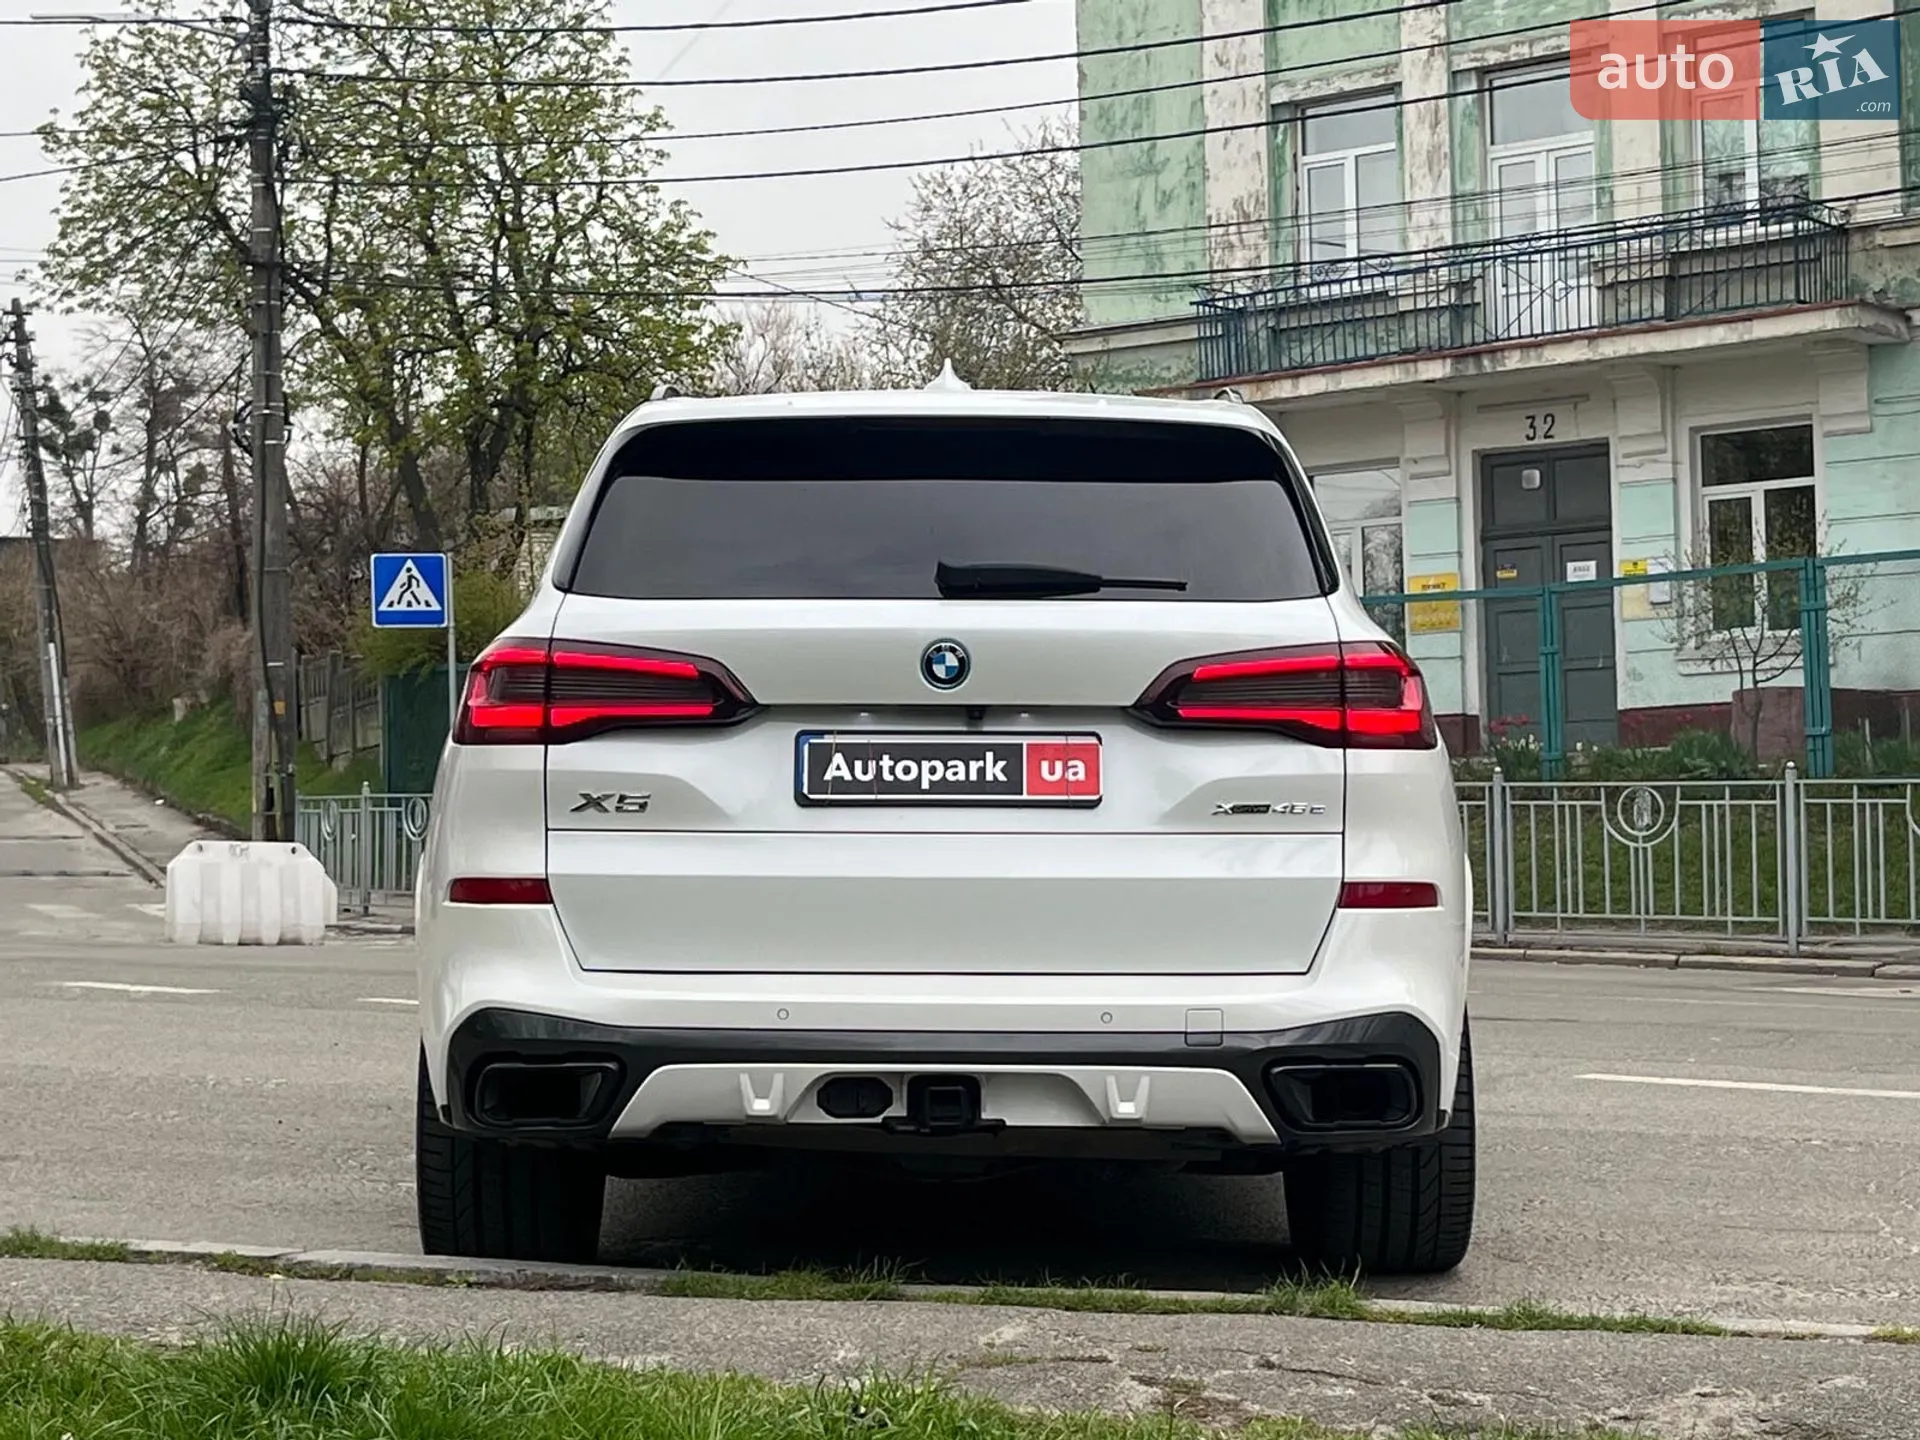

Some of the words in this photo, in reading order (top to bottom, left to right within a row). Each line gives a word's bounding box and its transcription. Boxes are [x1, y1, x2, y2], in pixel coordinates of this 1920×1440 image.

[1525, 413, 1555, 441] 32
[823, 751, 1007, 789] Autopark
[1040, 759, 1086, 781] ua
[569, 793, 651, 813] X5
